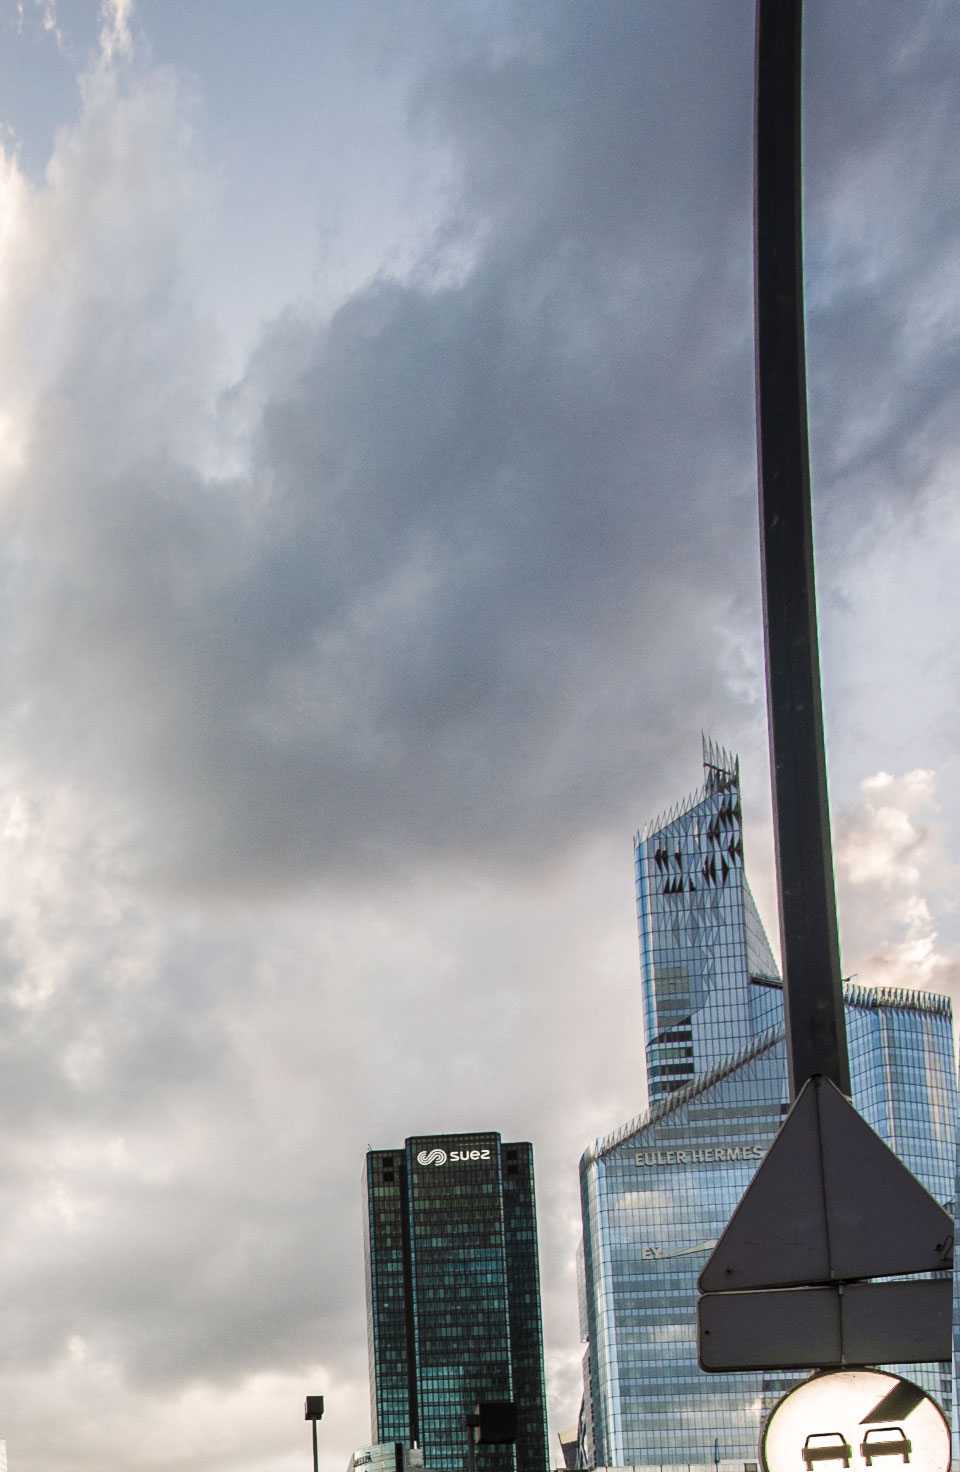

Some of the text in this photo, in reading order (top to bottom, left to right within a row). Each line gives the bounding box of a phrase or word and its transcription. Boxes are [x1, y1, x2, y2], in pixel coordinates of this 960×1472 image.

[450, 1150, 490, 1161] suez
[635, 1146, 763, 1167] EULER HERMES
[642, 1247, 662, 1259] EY
